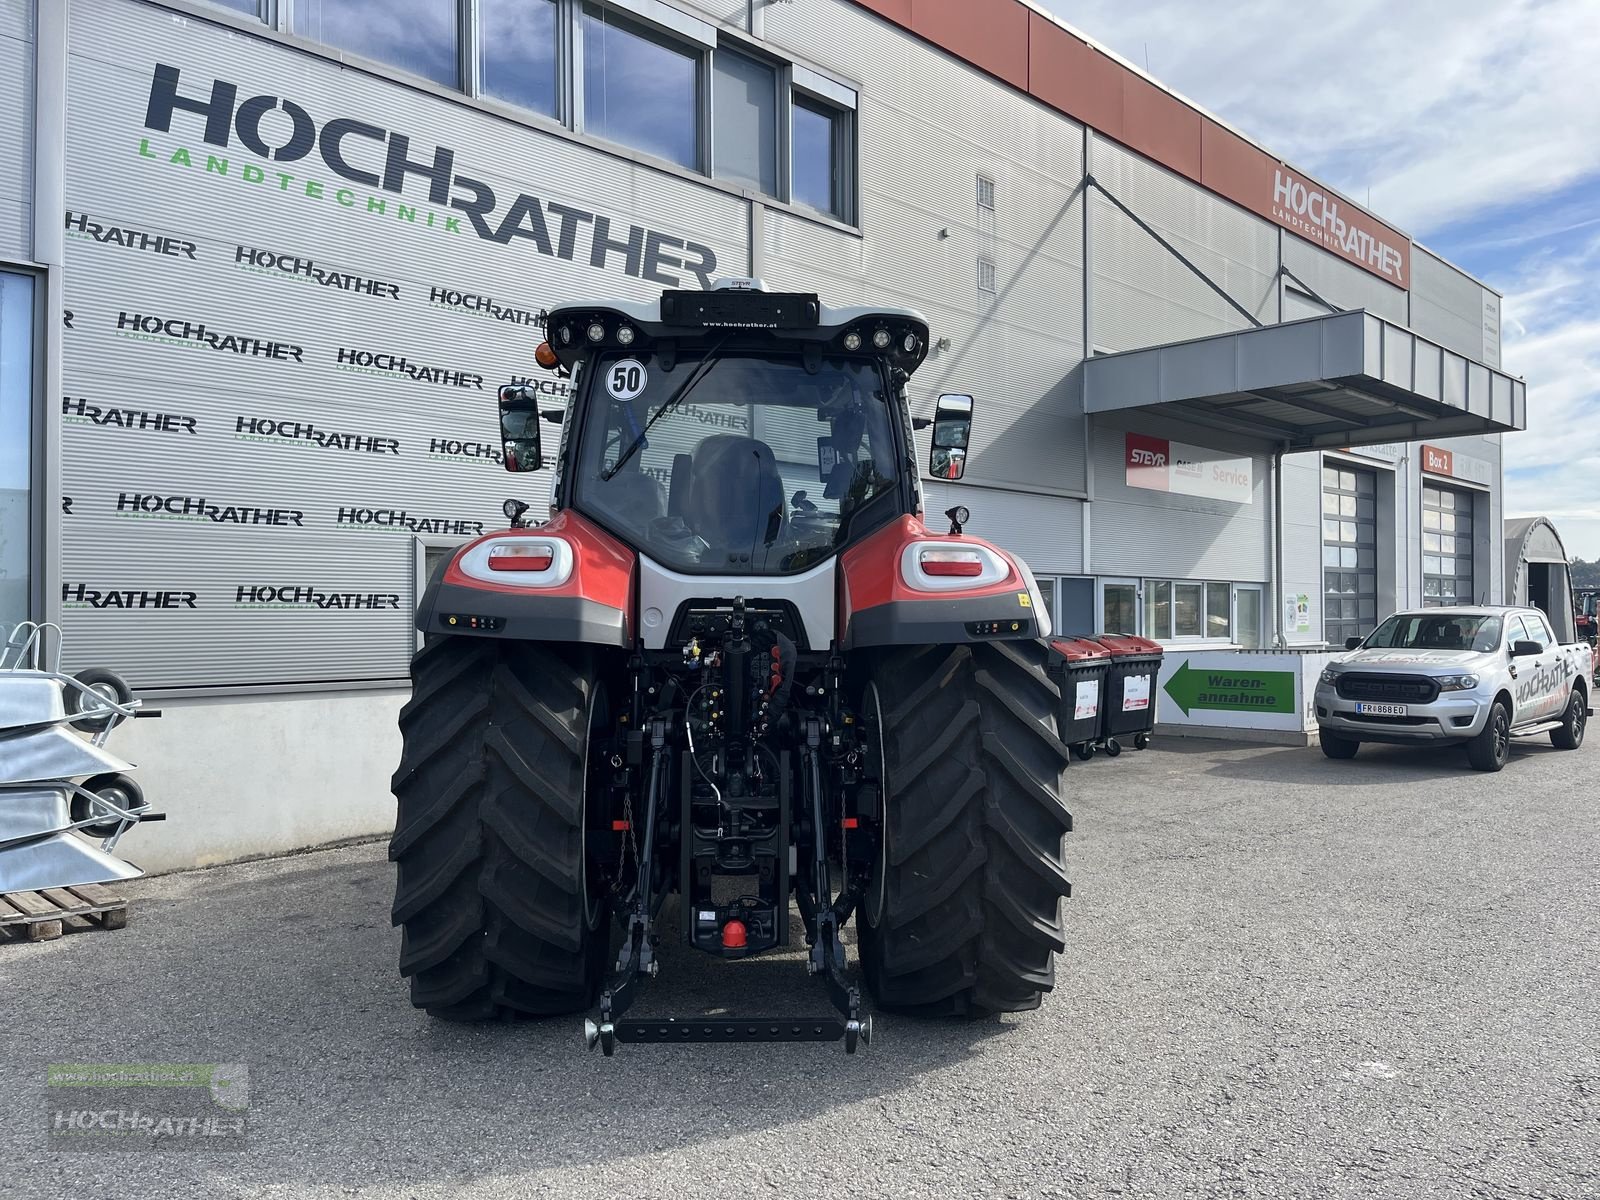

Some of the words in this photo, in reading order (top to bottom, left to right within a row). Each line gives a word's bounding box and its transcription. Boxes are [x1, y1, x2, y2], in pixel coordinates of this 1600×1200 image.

[138, 139, 463, 237] LANDTECHNIK
[144, 62, 718, 291] HOCHRATHER
[65, 212, 197, 260] HRATHER
[1272, 205, 1340, 249] LANDTECHNIK
[1273, 169, 1403, 281] HOCHRATHER
[235, 246, 400, 300] HOCHRATHER
[117, 312, 304, 363] HOCHRATHER
[337, 348, 483, 390] HOCHRATHER
[613, 367, 640, 392] 50
[63, 397, 197, 434] HRATHER
[235, 416, 400, 455] HOCHRATHER
[1131, 449, 1166, 466] STEYR
[1429, 451, 1442, 469] Box
[1443, 455, 1448, 470] 2
[1213, 465, 1248, 486] Service
[117, 493, 304, 527] HOCHRATHER
[337, 507, 484, 536] HOCHRATHER
[62, 583, 197, 609] HRATHER
[235, 586, 400, 609] HOCHRATHER
[1208, 675, 1266, 688] Waren-
[1198, 693, 1277, 705] annahme
[1362, 704, 1373, 713] FR
